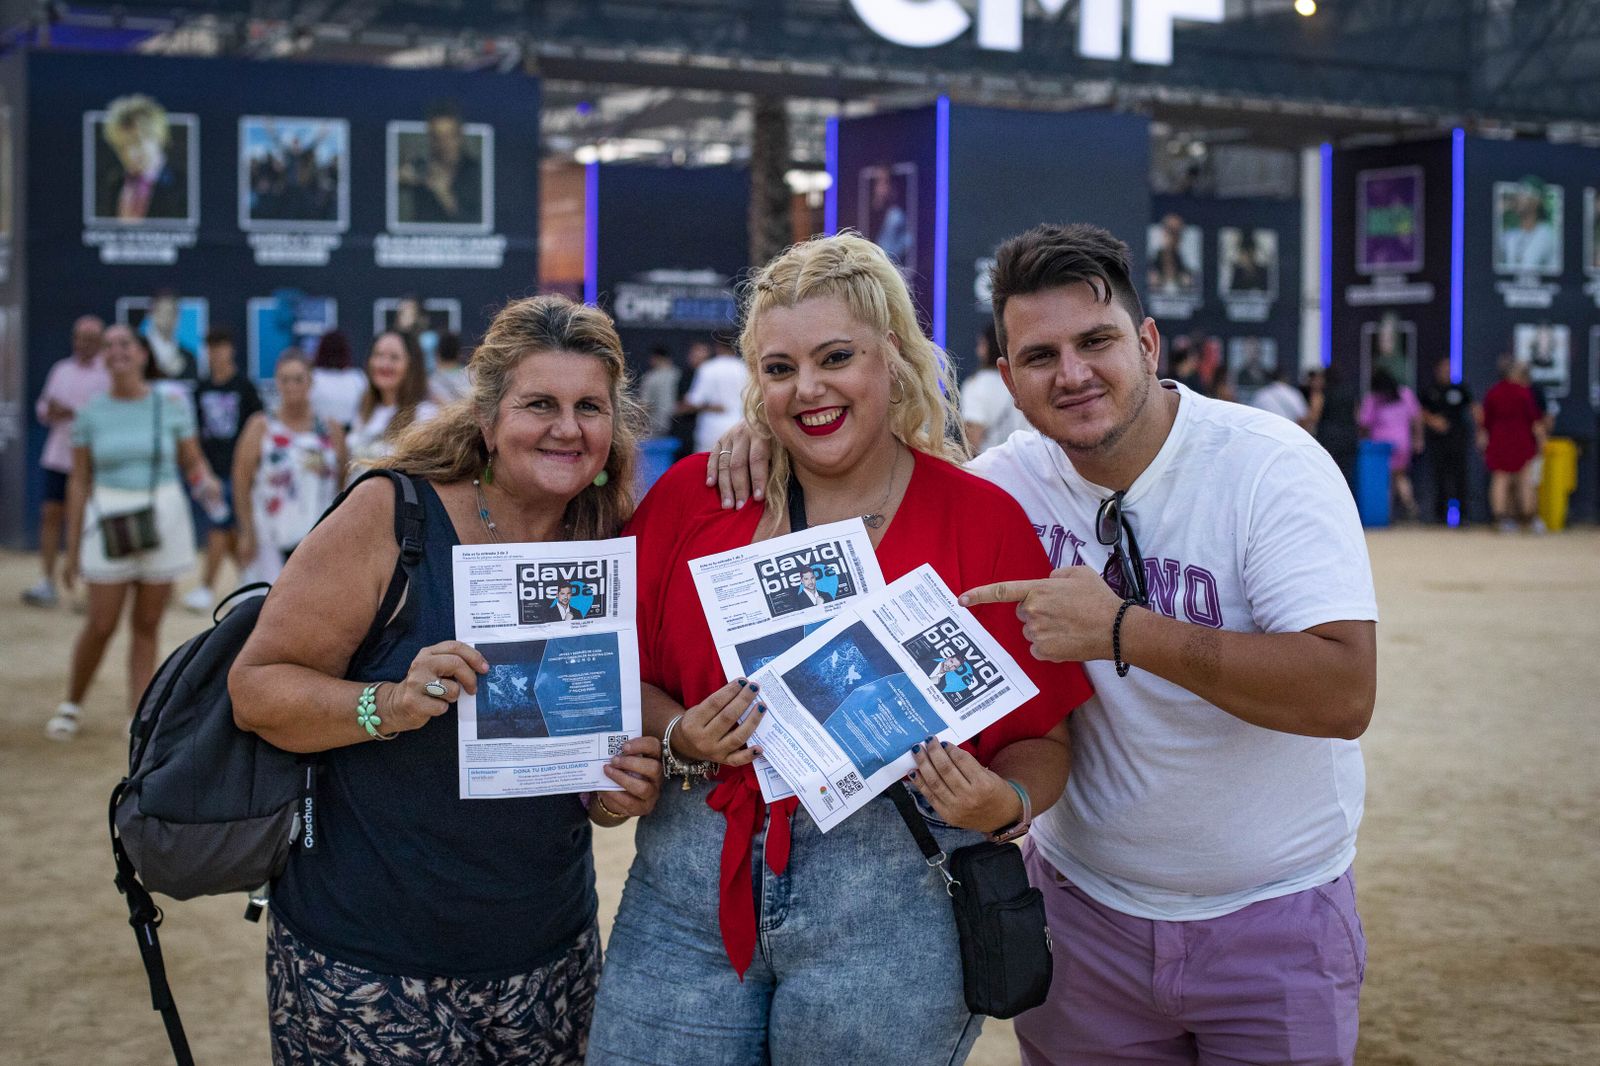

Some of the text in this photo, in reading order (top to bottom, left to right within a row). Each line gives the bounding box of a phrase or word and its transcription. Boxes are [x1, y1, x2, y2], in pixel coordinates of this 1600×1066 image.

[522, 560, 602, 582] david
[761, 541, 840, 578] david
[940, 622, 1004, 686] david
[786, 738, 798, 750] EURO
[796, 750, 817, 772] SOLIDARIO
[304, 797, 314, 848] Quechua
